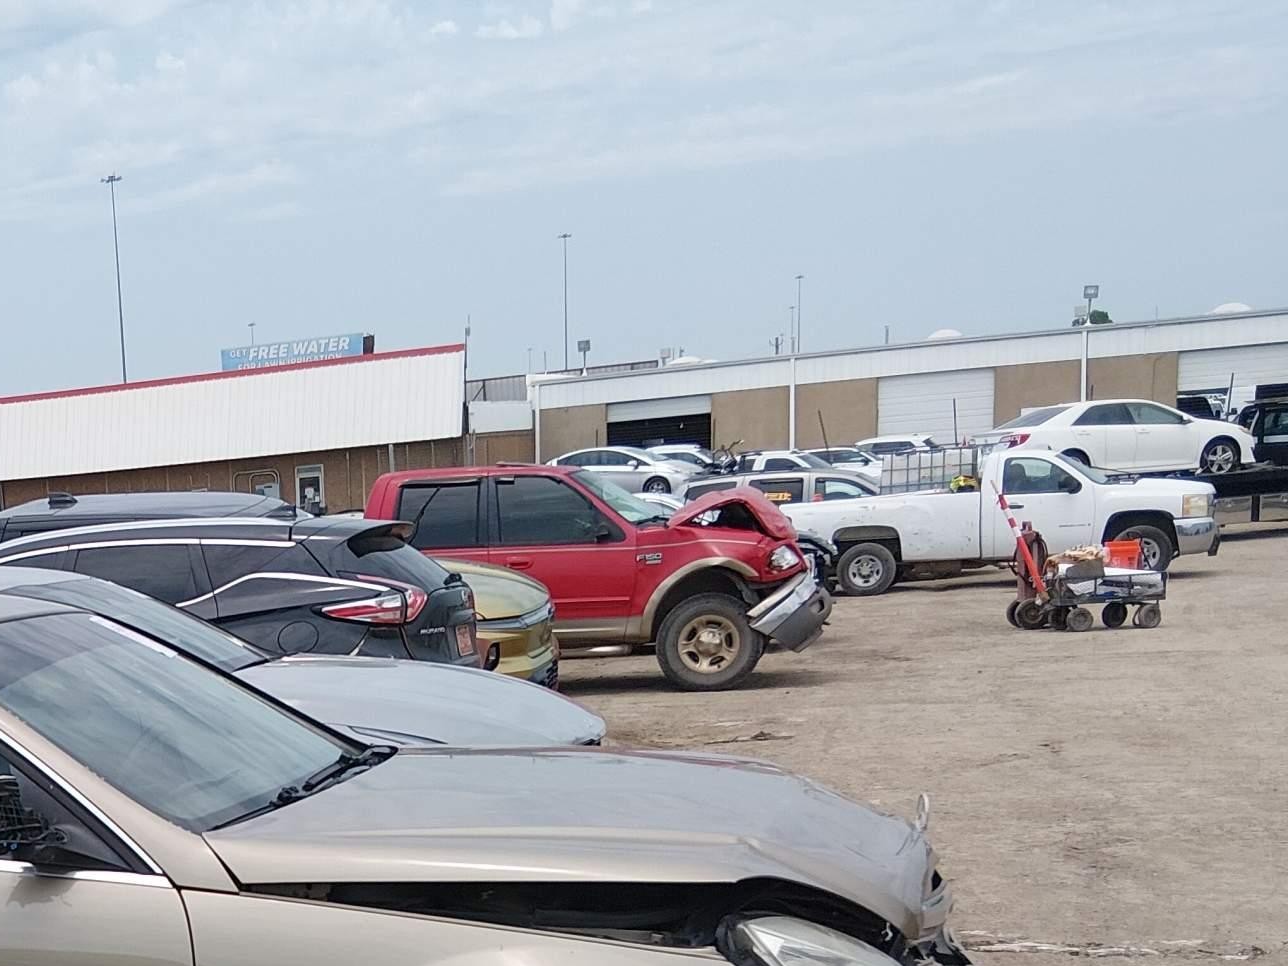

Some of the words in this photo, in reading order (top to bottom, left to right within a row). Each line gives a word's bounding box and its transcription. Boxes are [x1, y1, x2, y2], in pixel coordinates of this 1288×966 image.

[230, 349, 248, 358] GET
[248, 343, 289, 361] FREE
[292, 336, 350, 355] WATER
